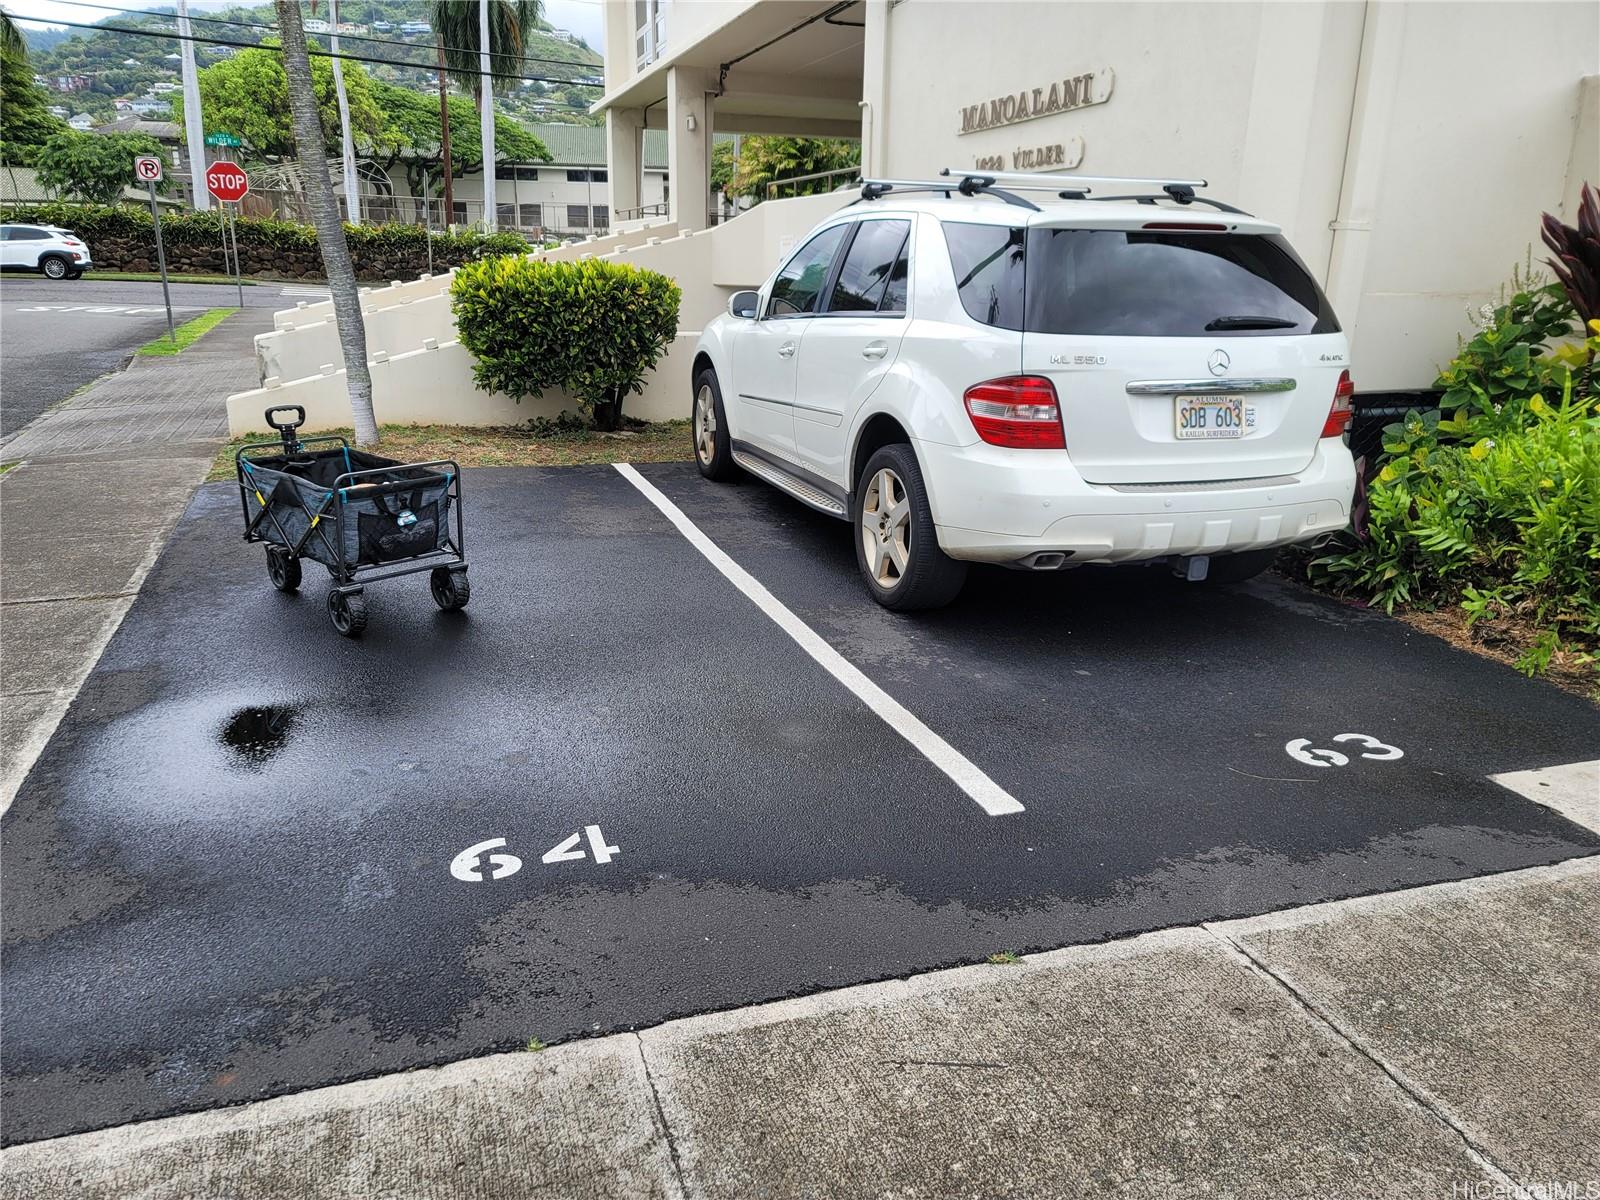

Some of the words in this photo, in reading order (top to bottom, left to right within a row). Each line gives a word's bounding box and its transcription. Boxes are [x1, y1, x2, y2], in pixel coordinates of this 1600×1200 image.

[961, 73, 1094, 132] MANOALANI
[208, 137, 232, 145] WILDER
[209, 174, 245, 189] STOP
[1049, 355, 1071, 364] ML
[1074, 355, 1107, 365] 550
[1181, 407, 1207, 428] SDB
[1215, 407, 1242, 428] 603
[1185, 430, 1205, 438] KAILUA
[1206, 429, 1239, 438] SURFRIDERS
[1285, 733, 1404, 767] 63
[450, 825, 621, 882] 64
